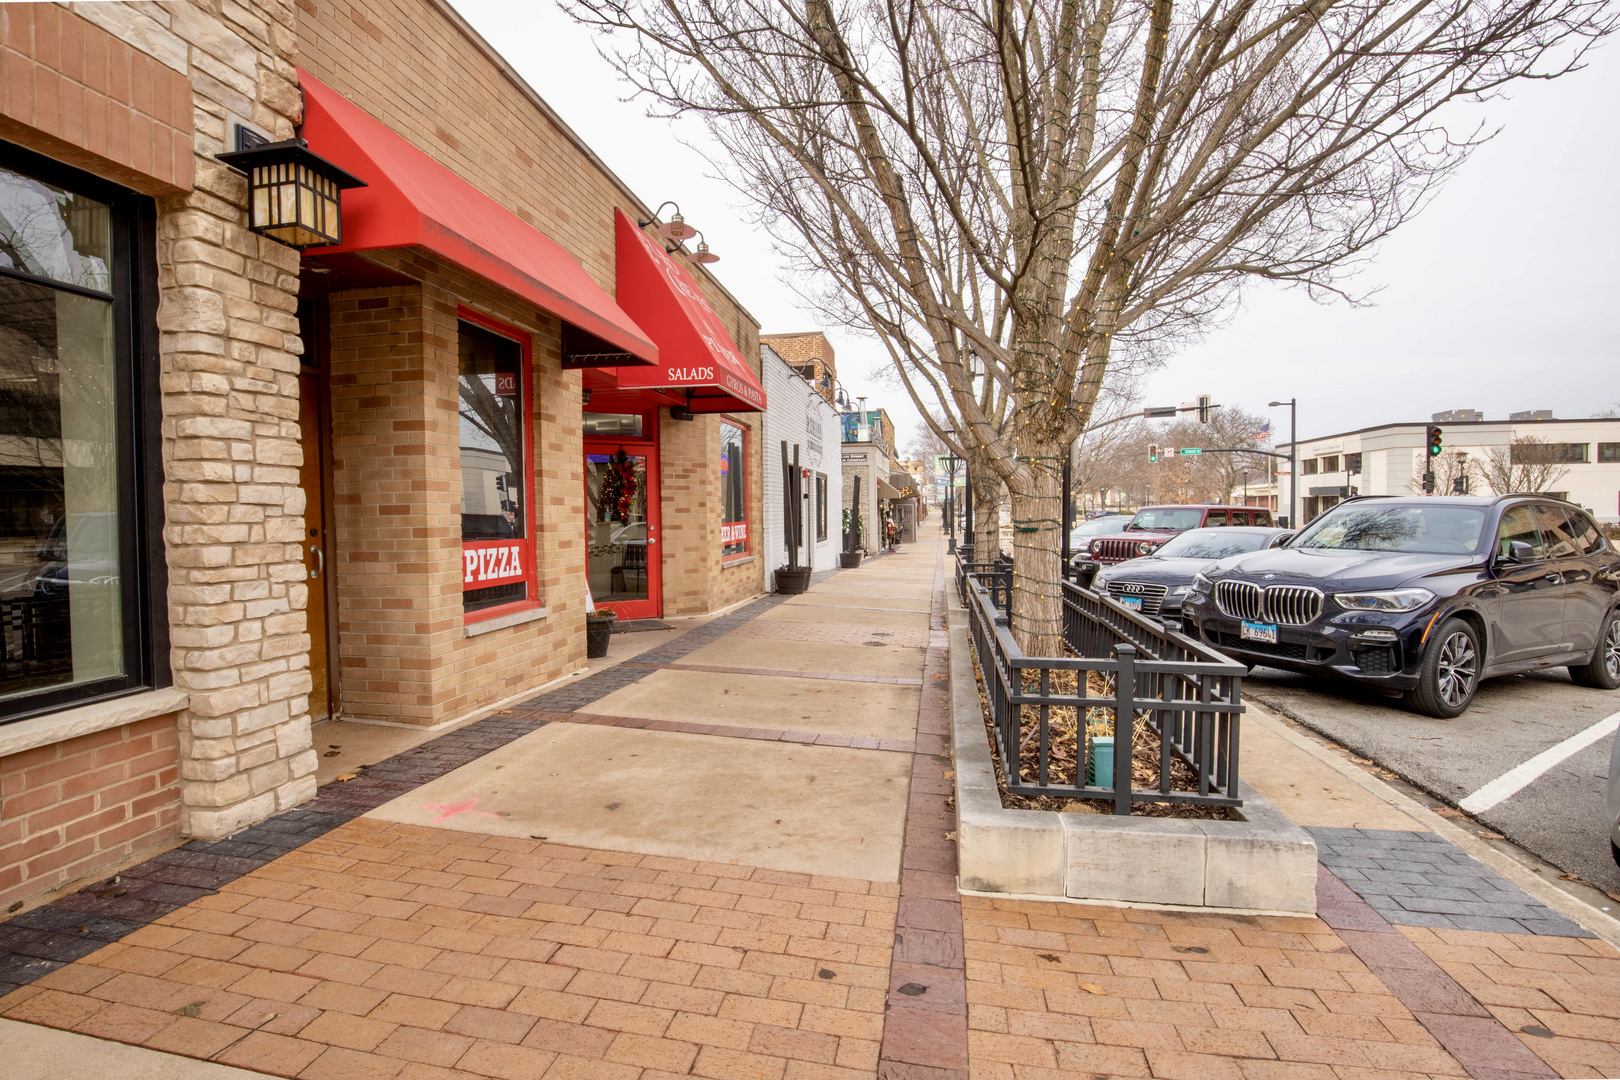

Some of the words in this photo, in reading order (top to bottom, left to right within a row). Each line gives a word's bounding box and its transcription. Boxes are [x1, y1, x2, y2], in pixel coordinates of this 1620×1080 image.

[668, 366, 714, 381] SALADS
[726, 375, 744, 394] GYROS
[748, 387, 762, 405] PASTA
[735, 524, 746, 540] WINE
[464, 546, 522, 583] PIZZA
[1254, 627, 1276, 640] 69641
